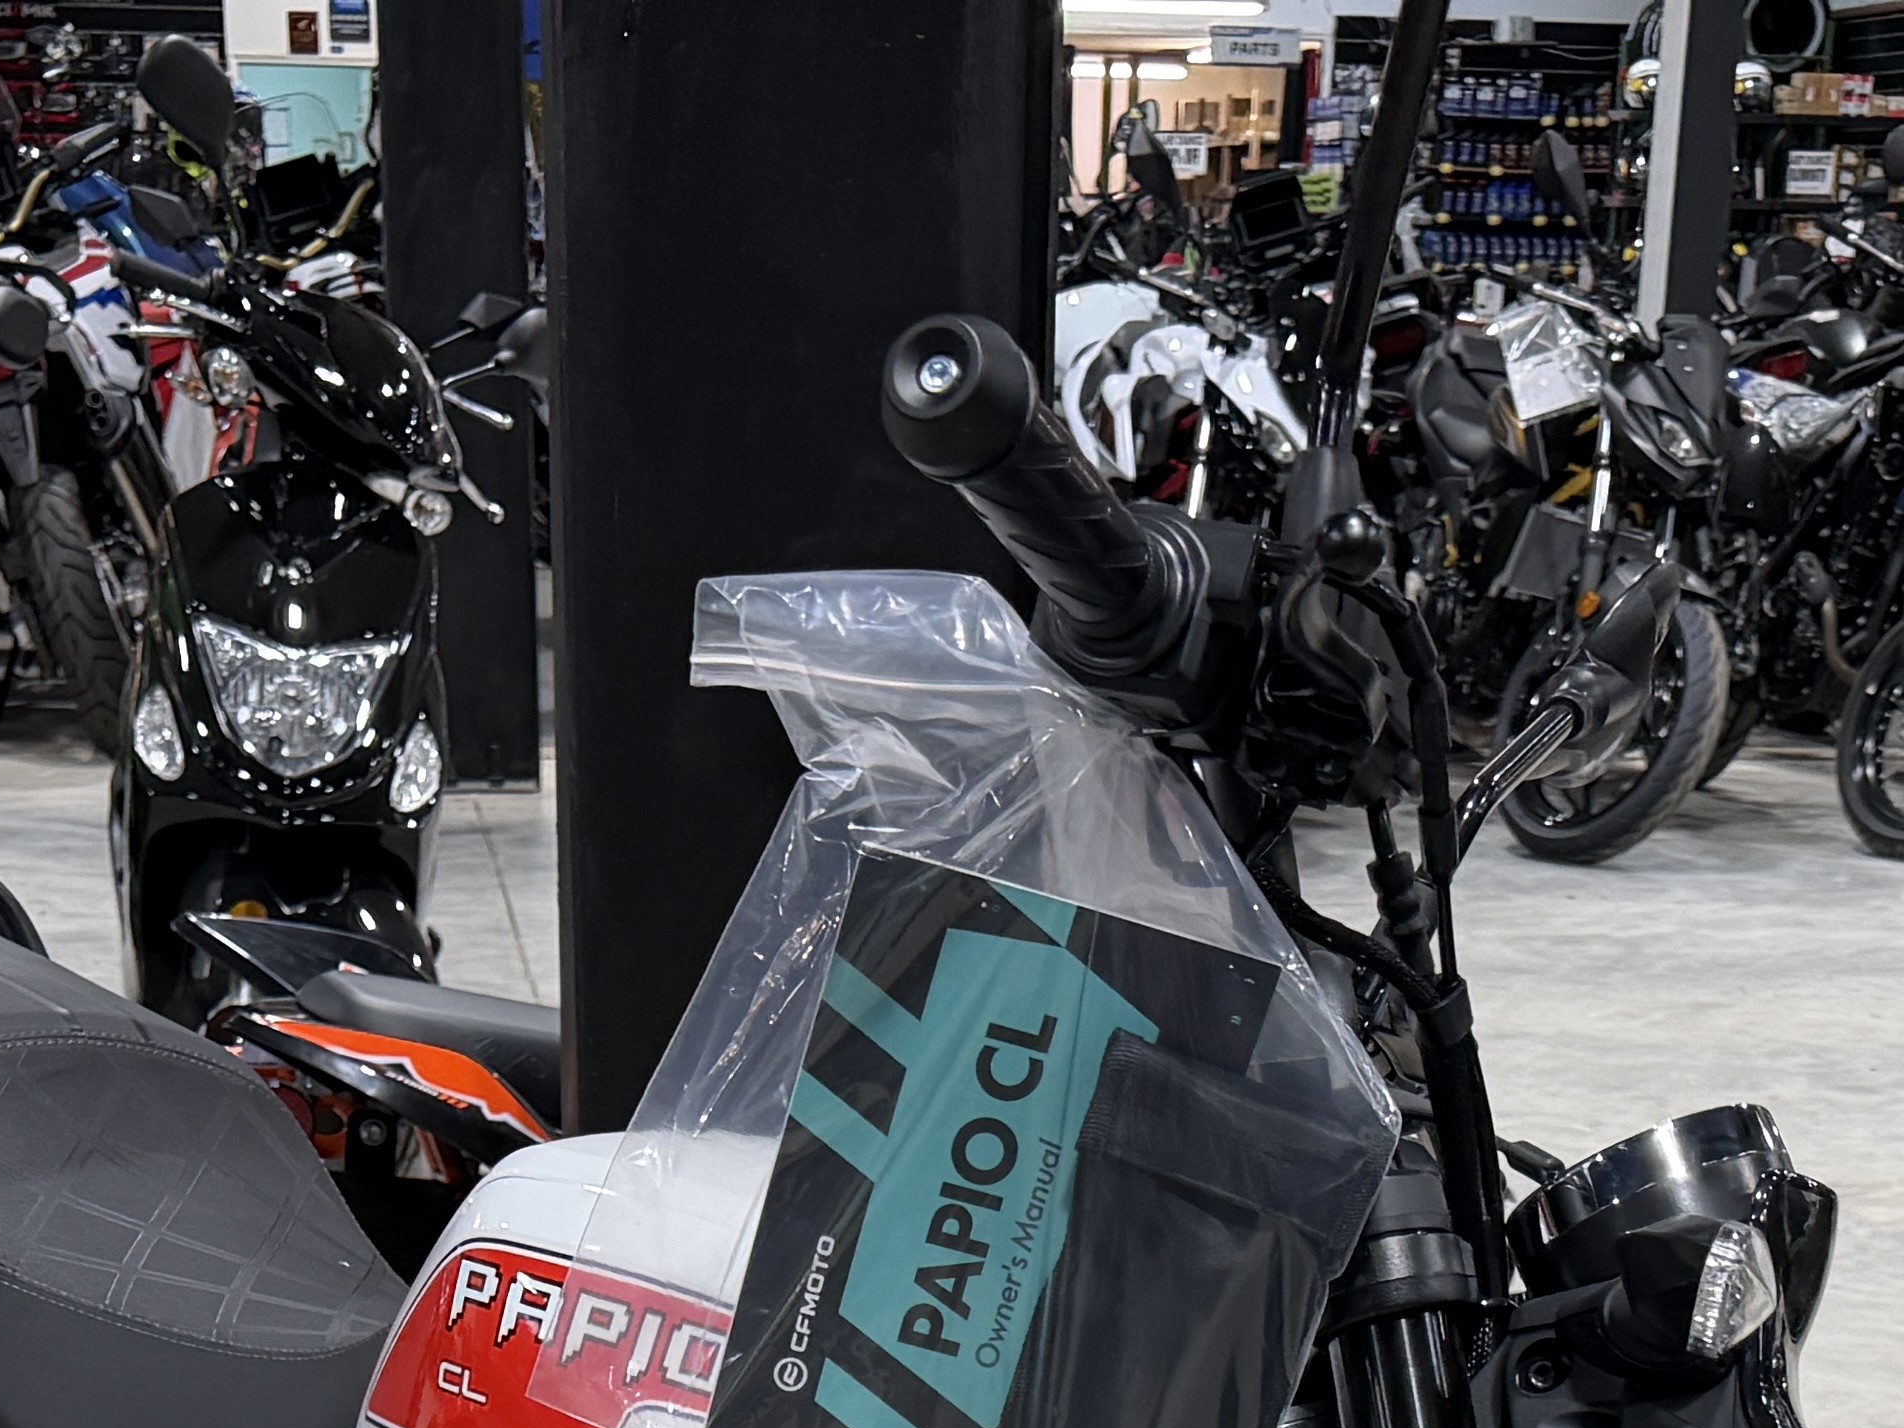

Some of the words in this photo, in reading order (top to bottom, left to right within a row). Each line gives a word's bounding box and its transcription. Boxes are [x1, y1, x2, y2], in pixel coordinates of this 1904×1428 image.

[1229, 41, 1281, 57] PARTS
[897, 1116, 1019, 1358] PAPIO
[975, 1014, 1060, 1102] CL
[790, 1235, 836, 1353] CFMOTO
[974, 1254, 1029, 1370] Owner's
[1011, 1138, 1064, 1252] Manual
[437, 1360, 488, 1405] CL
[447, 1257, 728, 1393] PAPIO
